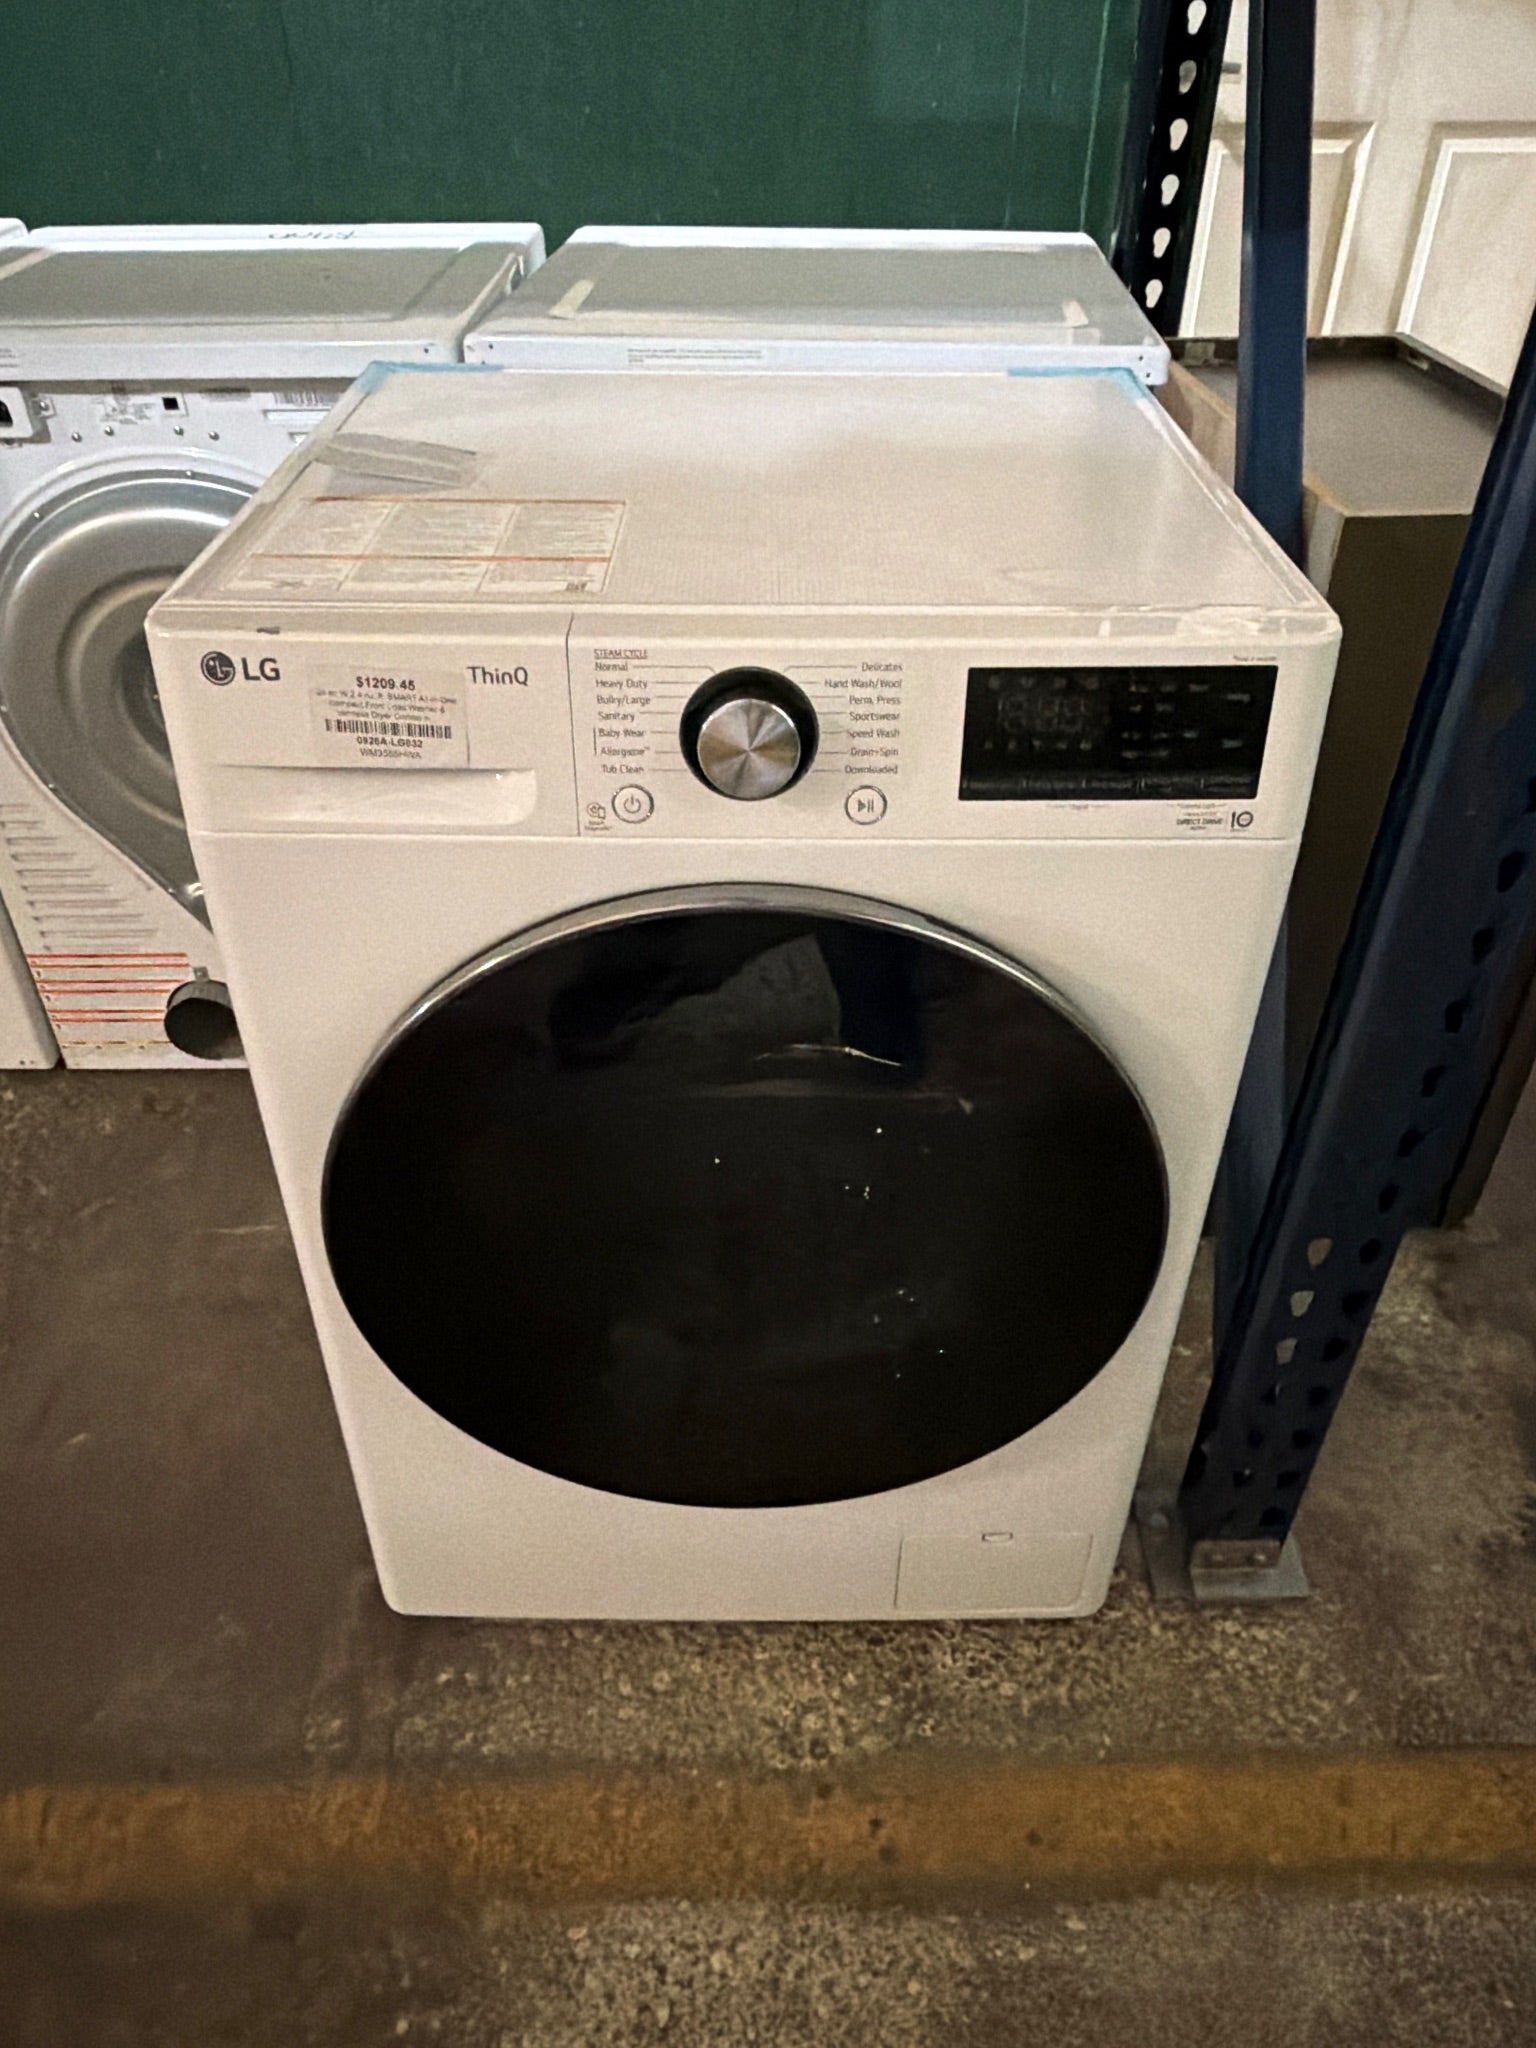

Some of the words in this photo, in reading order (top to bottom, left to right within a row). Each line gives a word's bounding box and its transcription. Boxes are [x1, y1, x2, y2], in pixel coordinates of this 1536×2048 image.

[241, 656, 281, 681] LG
[594, 661, 628, 671] Normal
[466, 666, 529, 687] ThinQ
[595, 679, 623, 690] Heavy
[598, 711, 635, 722] Sanitary
[849, 711, 900, 722] Sportswear
